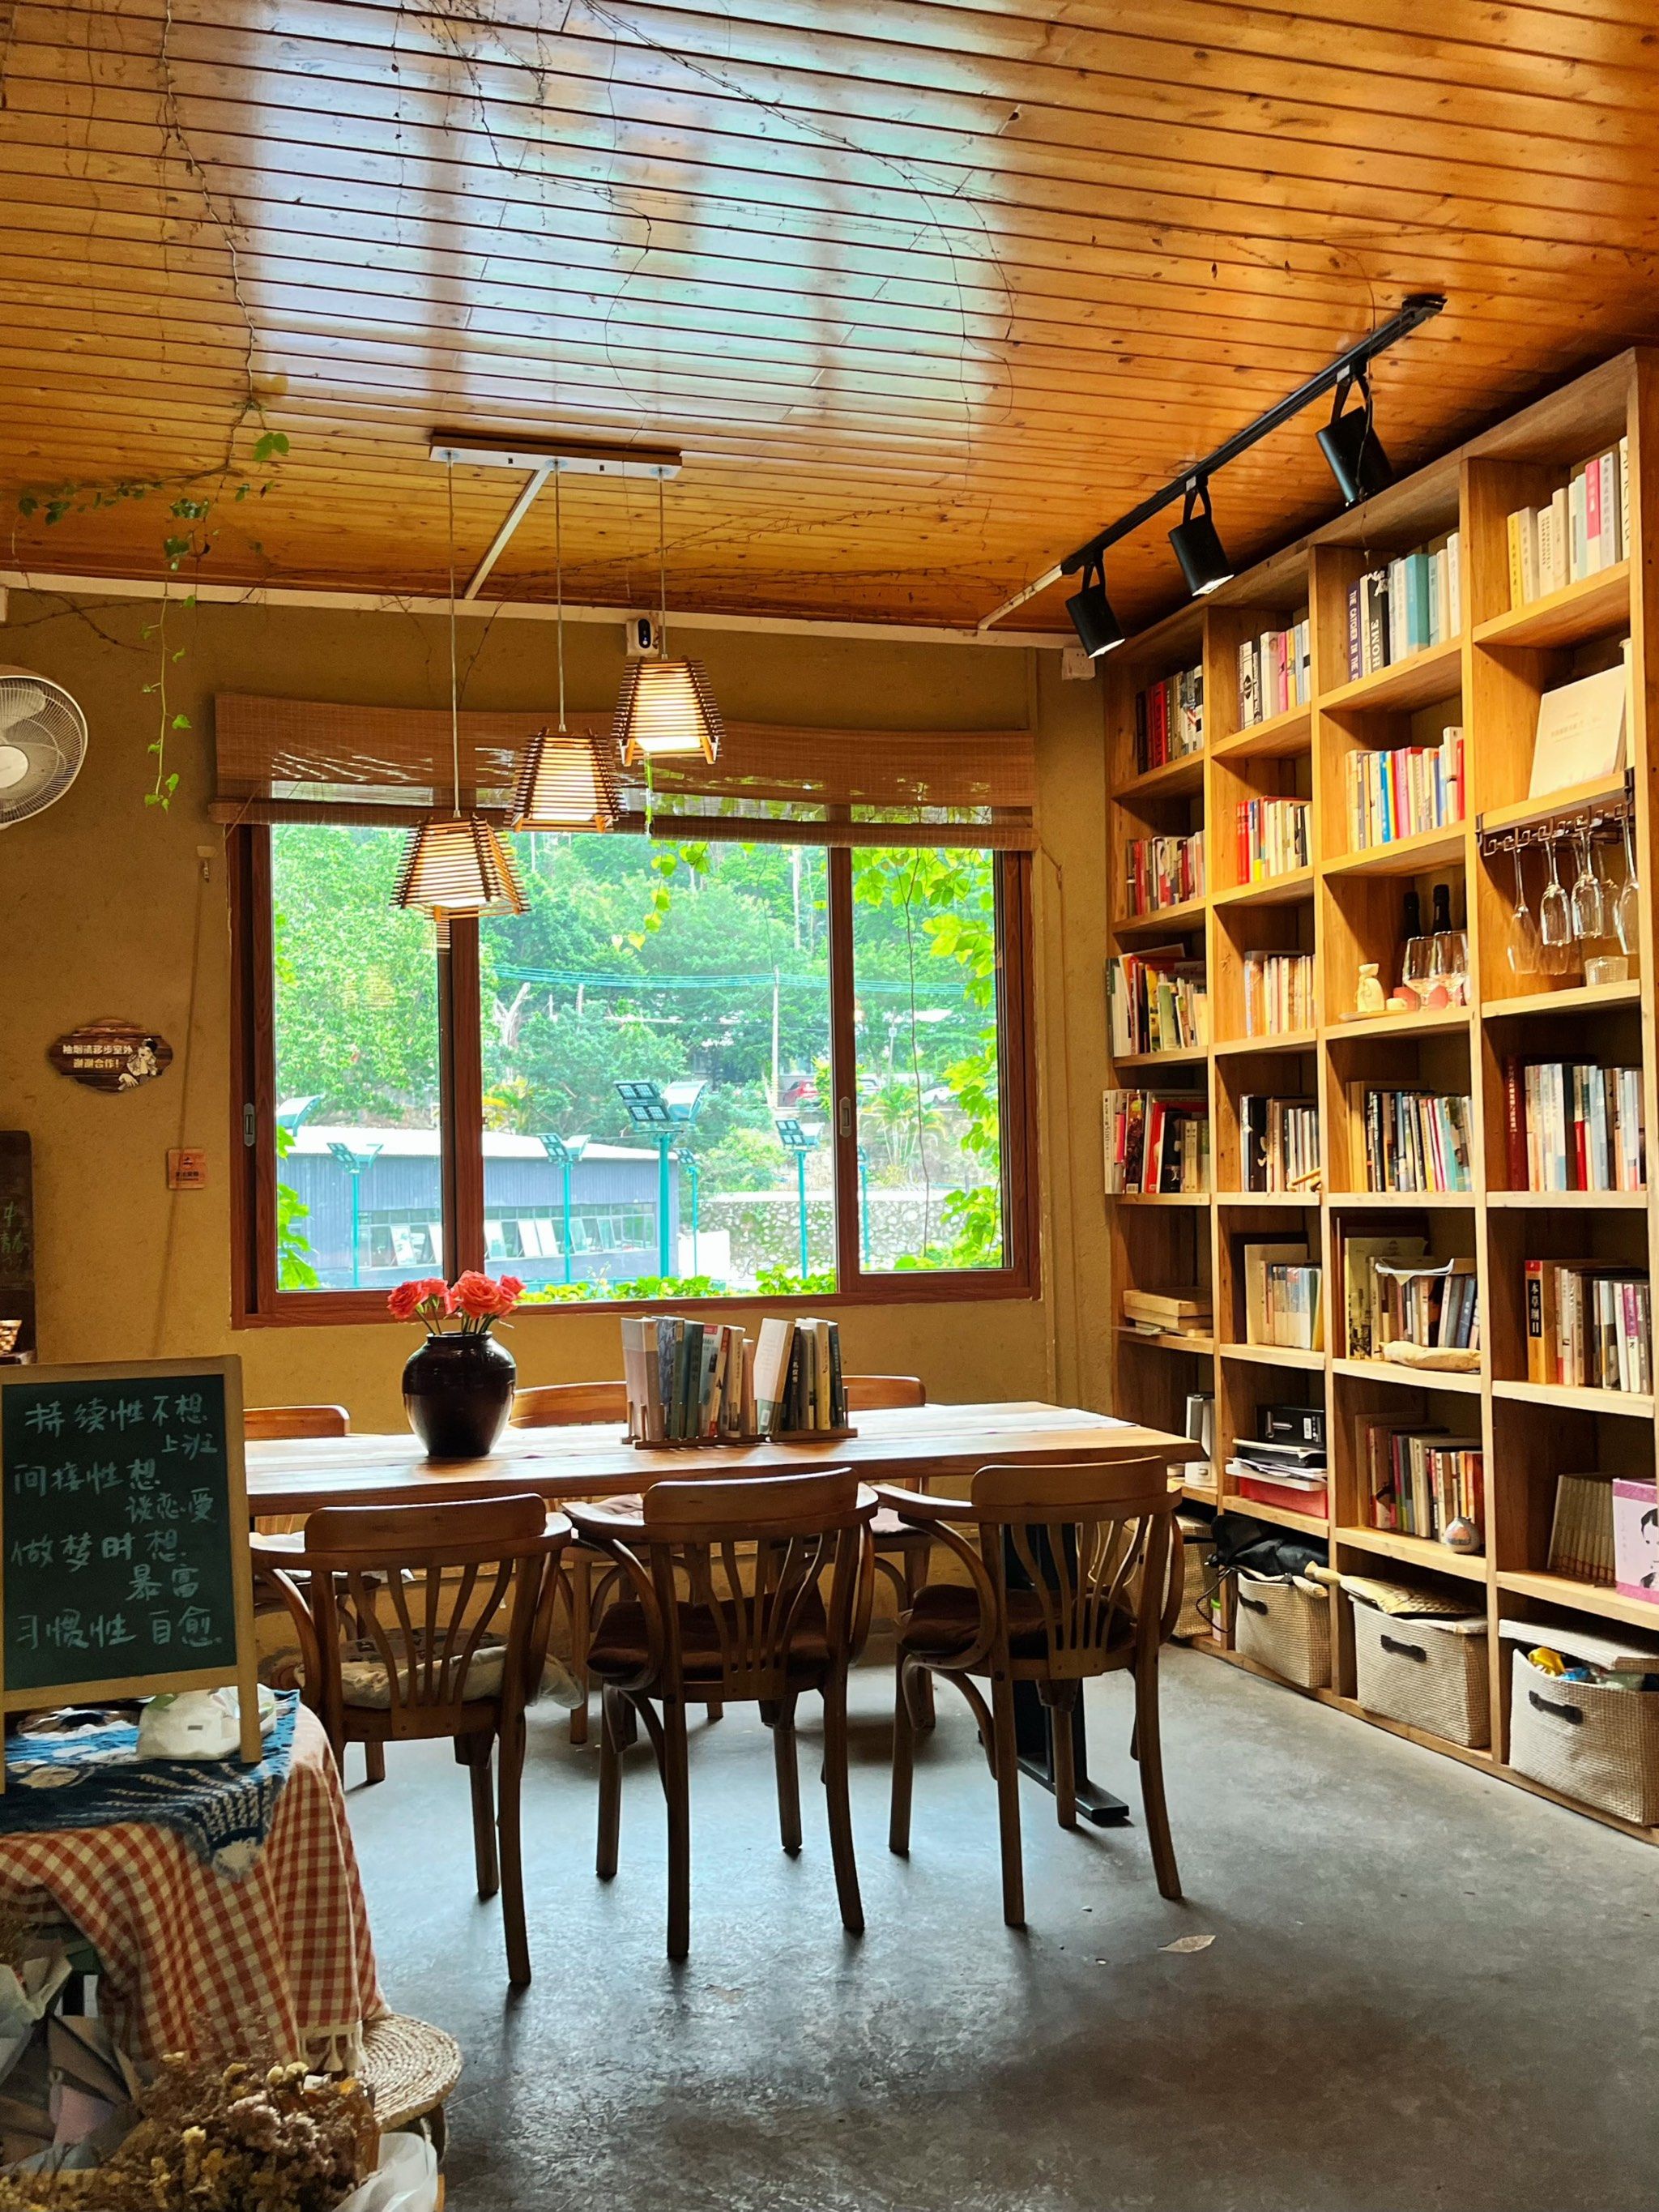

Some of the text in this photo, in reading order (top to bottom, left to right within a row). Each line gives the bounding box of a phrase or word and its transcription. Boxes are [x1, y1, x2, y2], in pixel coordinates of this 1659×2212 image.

[1371, 619, 1380, 668] HOME
[162, 1433, 218, 1459] 上班
[126, 1564, 199, 1601] 暴富
